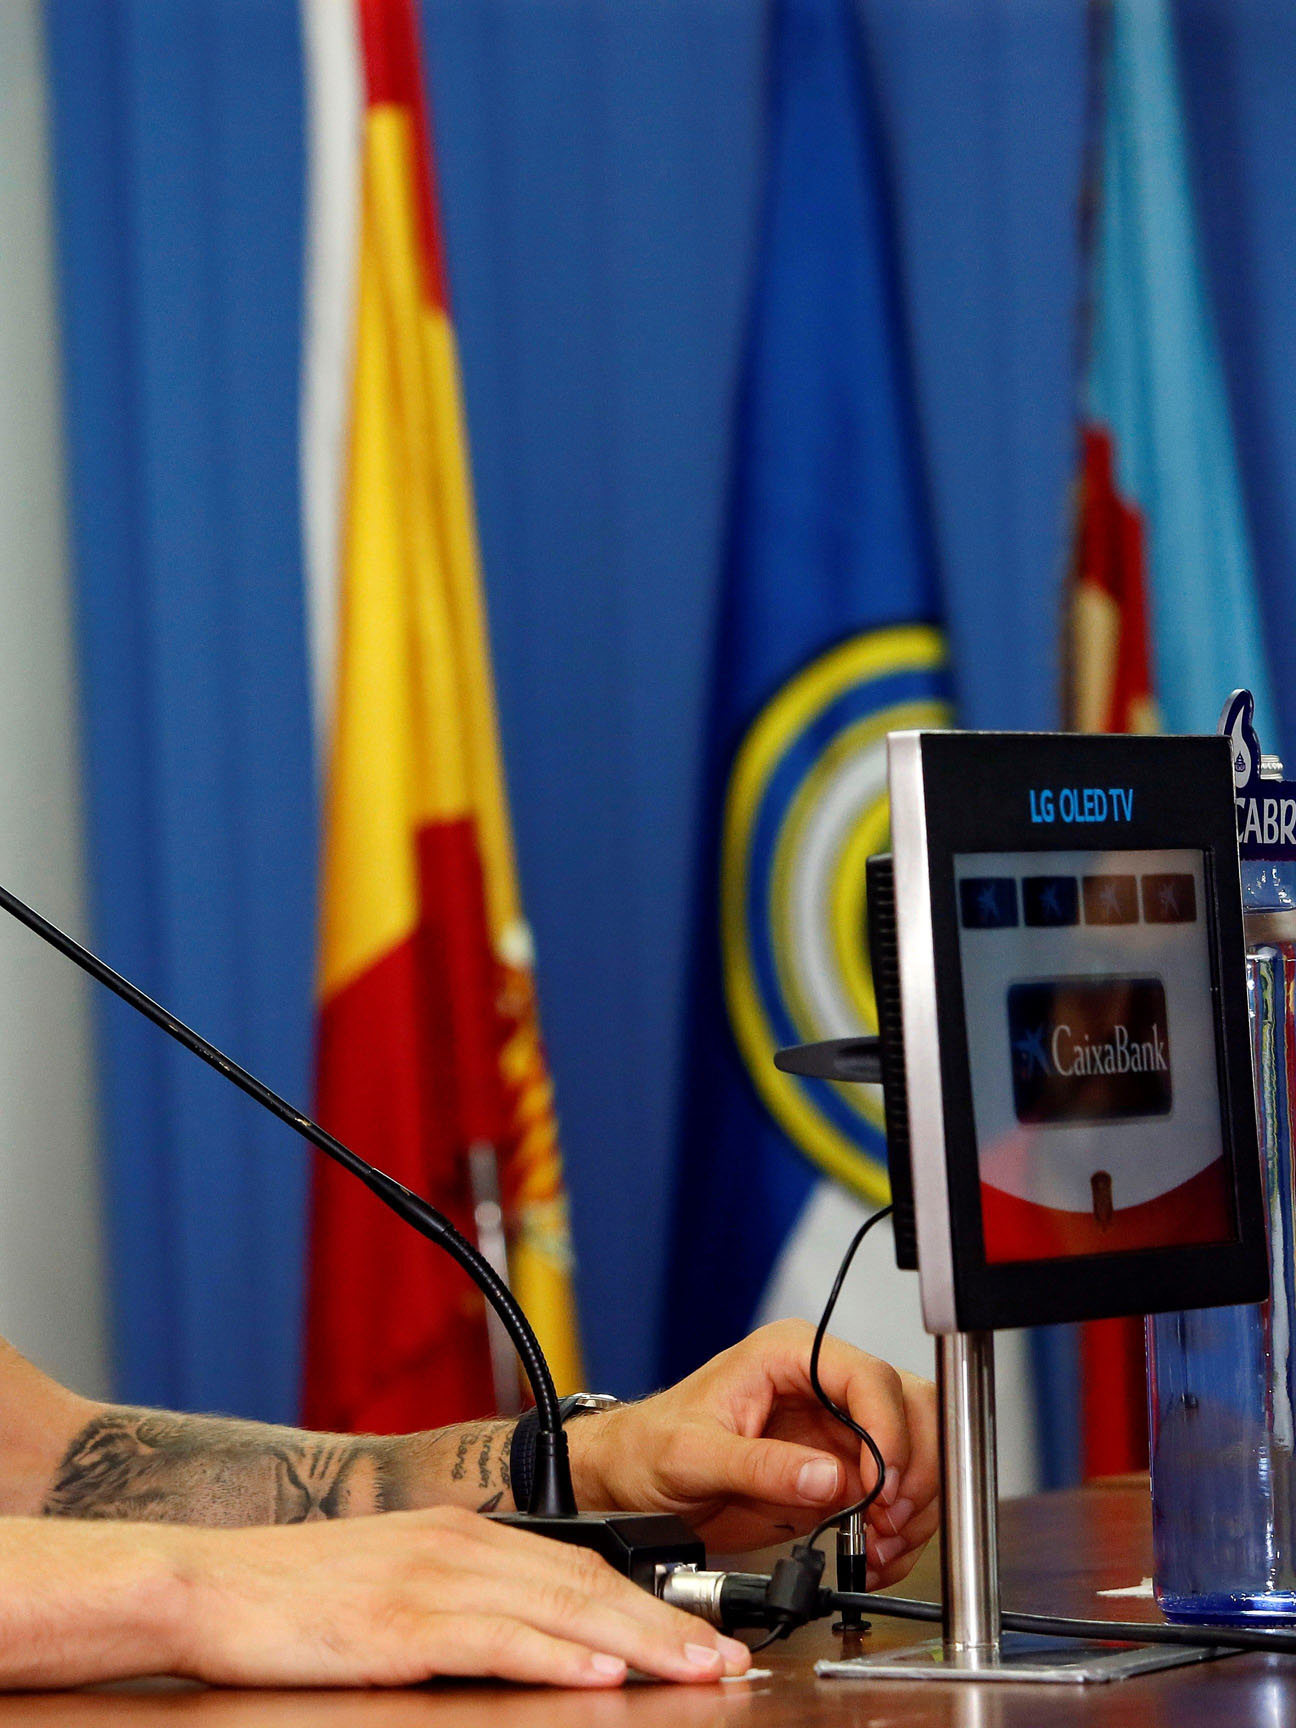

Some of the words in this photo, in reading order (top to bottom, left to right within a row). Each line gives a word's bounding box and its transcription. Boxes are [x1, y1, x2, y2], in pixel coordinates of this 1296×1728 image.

[1029, 788, 1055, 823] LG
[1059, 788, 1108, 823] OLED
[1108, 788, 1134, 822] TV
[1051, 1023, 1168, 1076] CaixaBank
